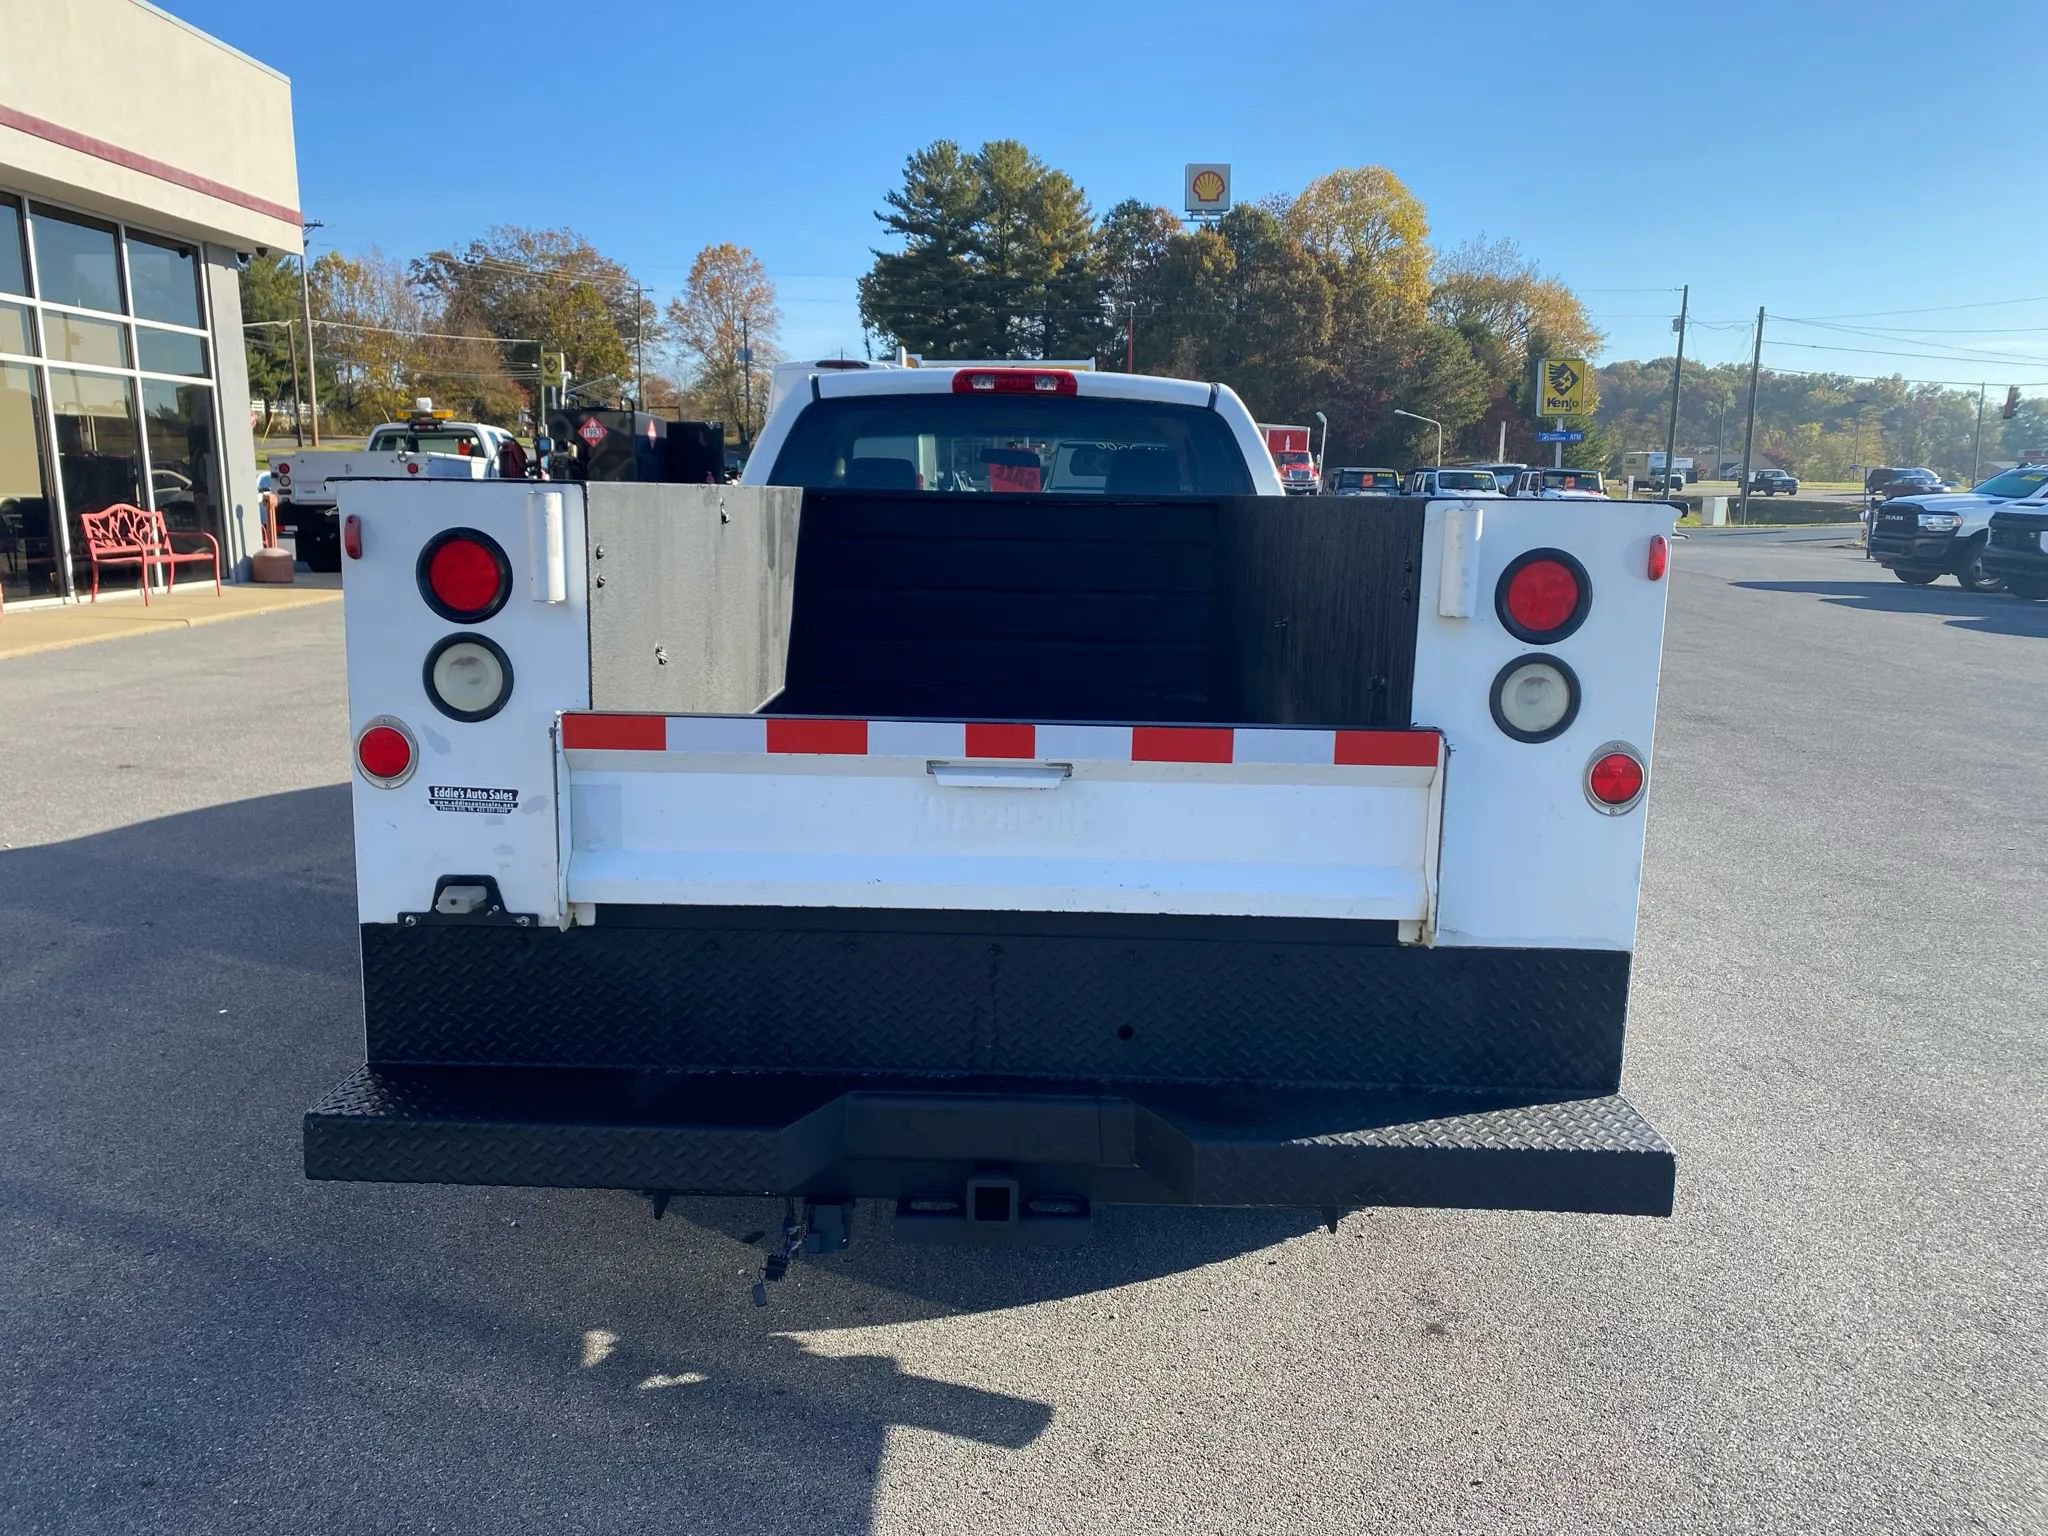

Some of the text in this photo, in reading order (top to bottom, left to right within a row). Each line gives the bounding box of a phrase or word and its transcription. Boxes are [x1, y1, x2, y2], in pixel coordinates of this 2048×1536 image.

[1546, 397, 1579, 411] Kenjo
[434, 787, 513, 800] Eddie's Auto Sales
